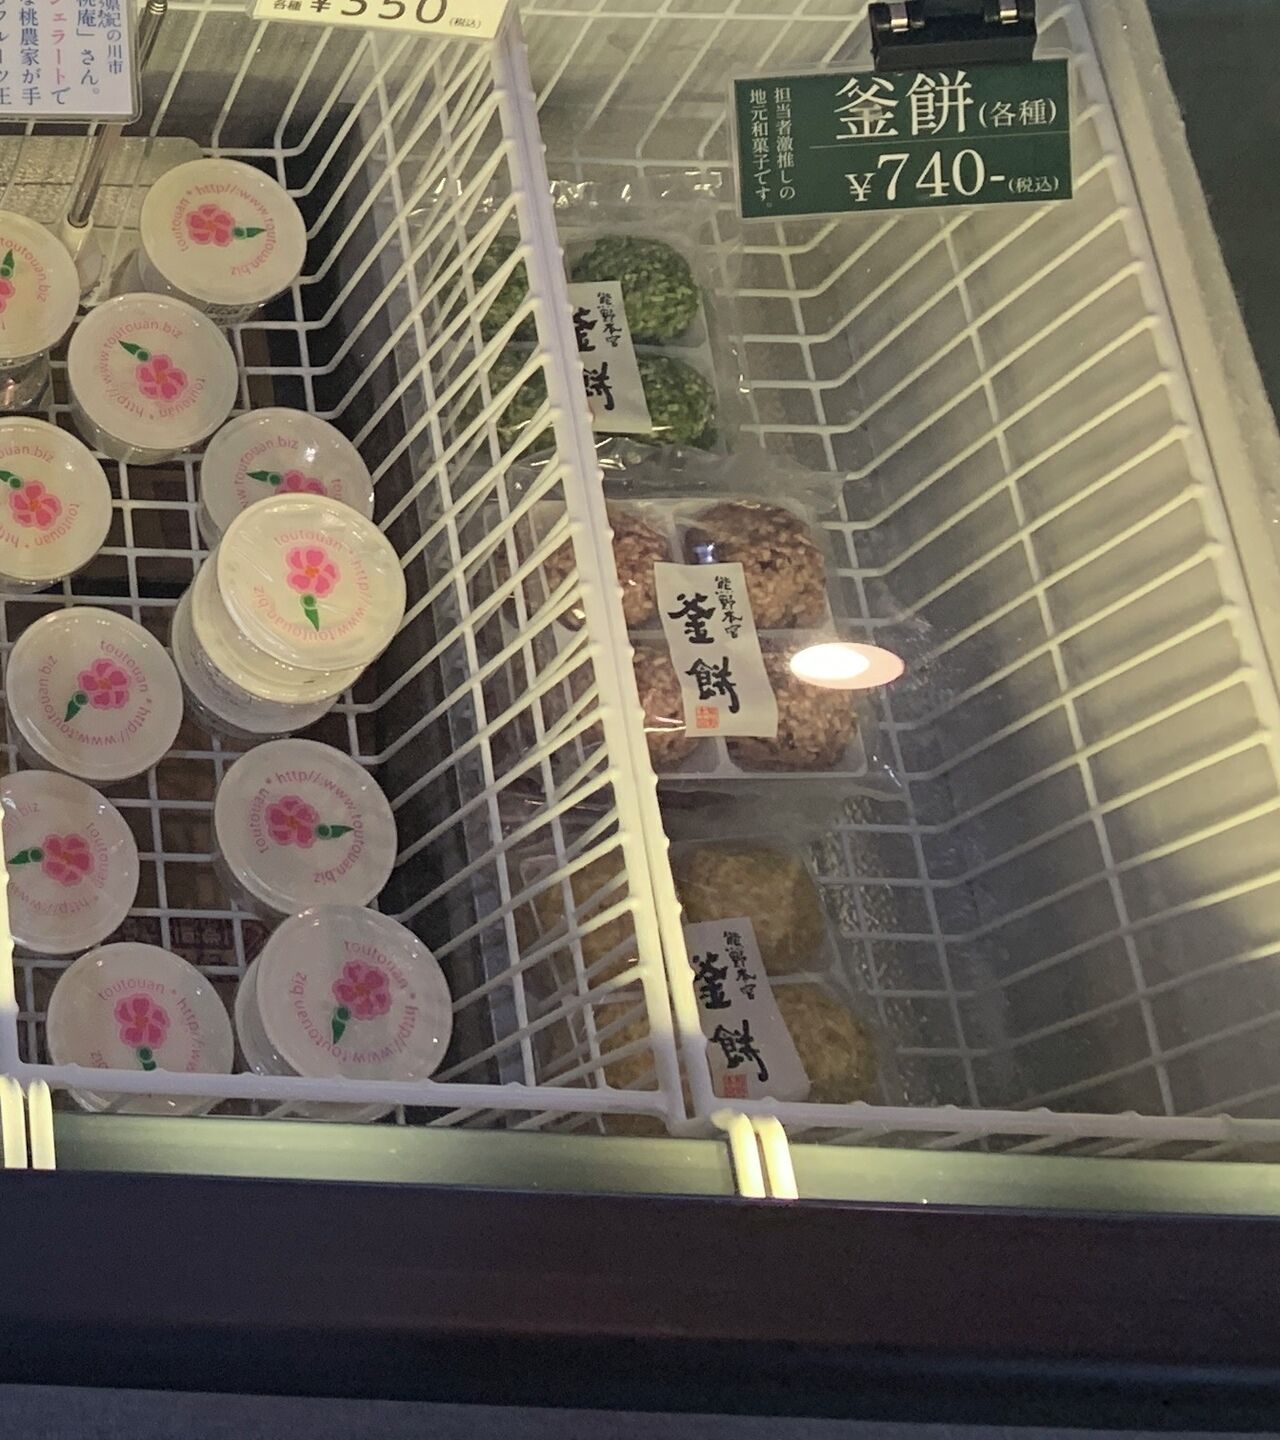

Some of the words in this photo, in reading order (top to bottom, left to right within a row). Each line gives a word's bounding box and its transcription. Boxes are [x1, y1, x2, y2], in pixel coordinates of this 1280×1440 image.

[834, 70, 975, 141] 釜餅
[978, 97, 1058, 129] (各種)
[749, 89, 773, 209] 地元和菓子です。
[774, 87, 796, 201] 担当者激推しの
[1007, 175, 1060, 194] (税込)
[172, 198, 190, 253] toutouan
[100, 640, 149, 692] toutouan
[667, 592, 741, 716] 釜餅
[98, 978, 166, 1002] toutouan
[692, 951, 770, 1083] 釜餅
